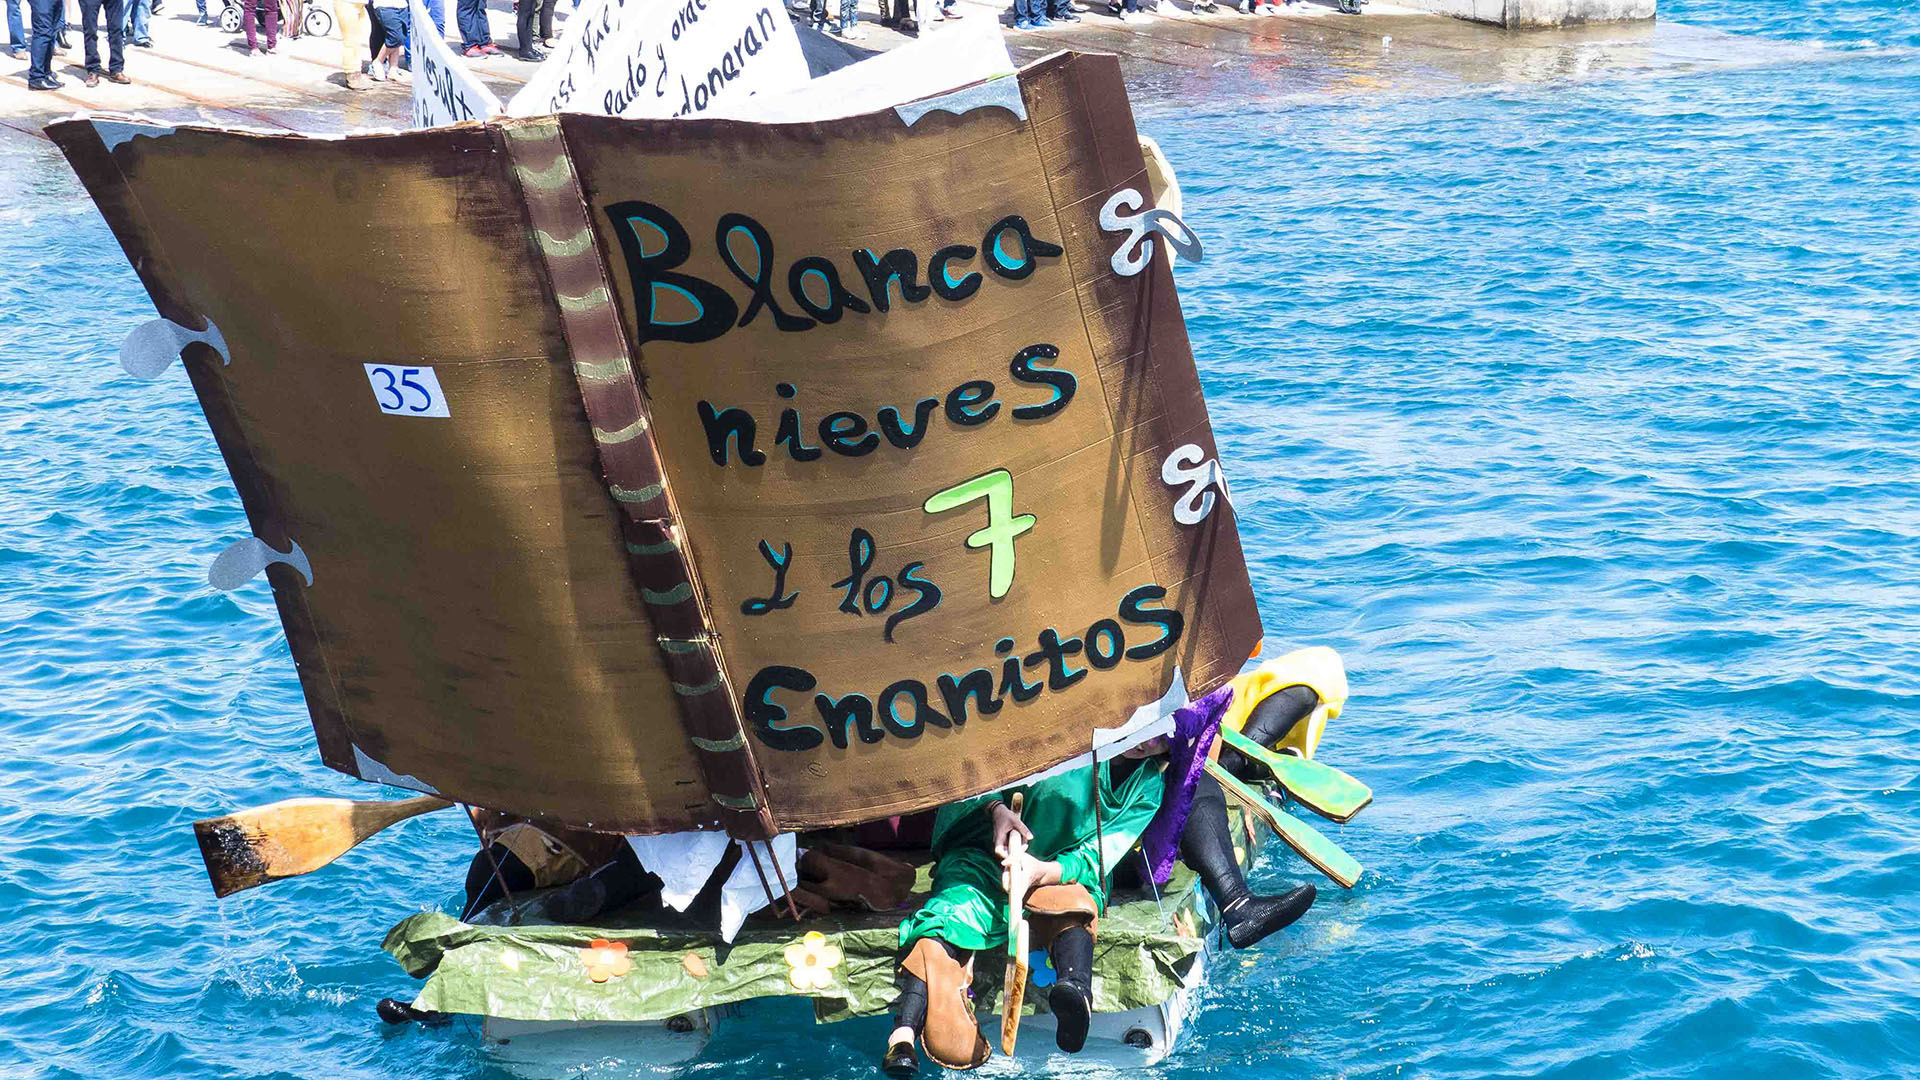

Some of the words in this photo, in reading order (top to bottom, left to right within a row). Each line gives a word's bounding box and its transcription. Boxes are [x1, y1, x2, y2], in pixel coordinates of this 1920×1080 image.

[672, 7, 776, 118] donaran
[604, 200, 1064, 347] Blanca
[372, 367, 432, 412] 35
[831, 527, 943, 644] los
[923, 467, 1037, 599] 7
